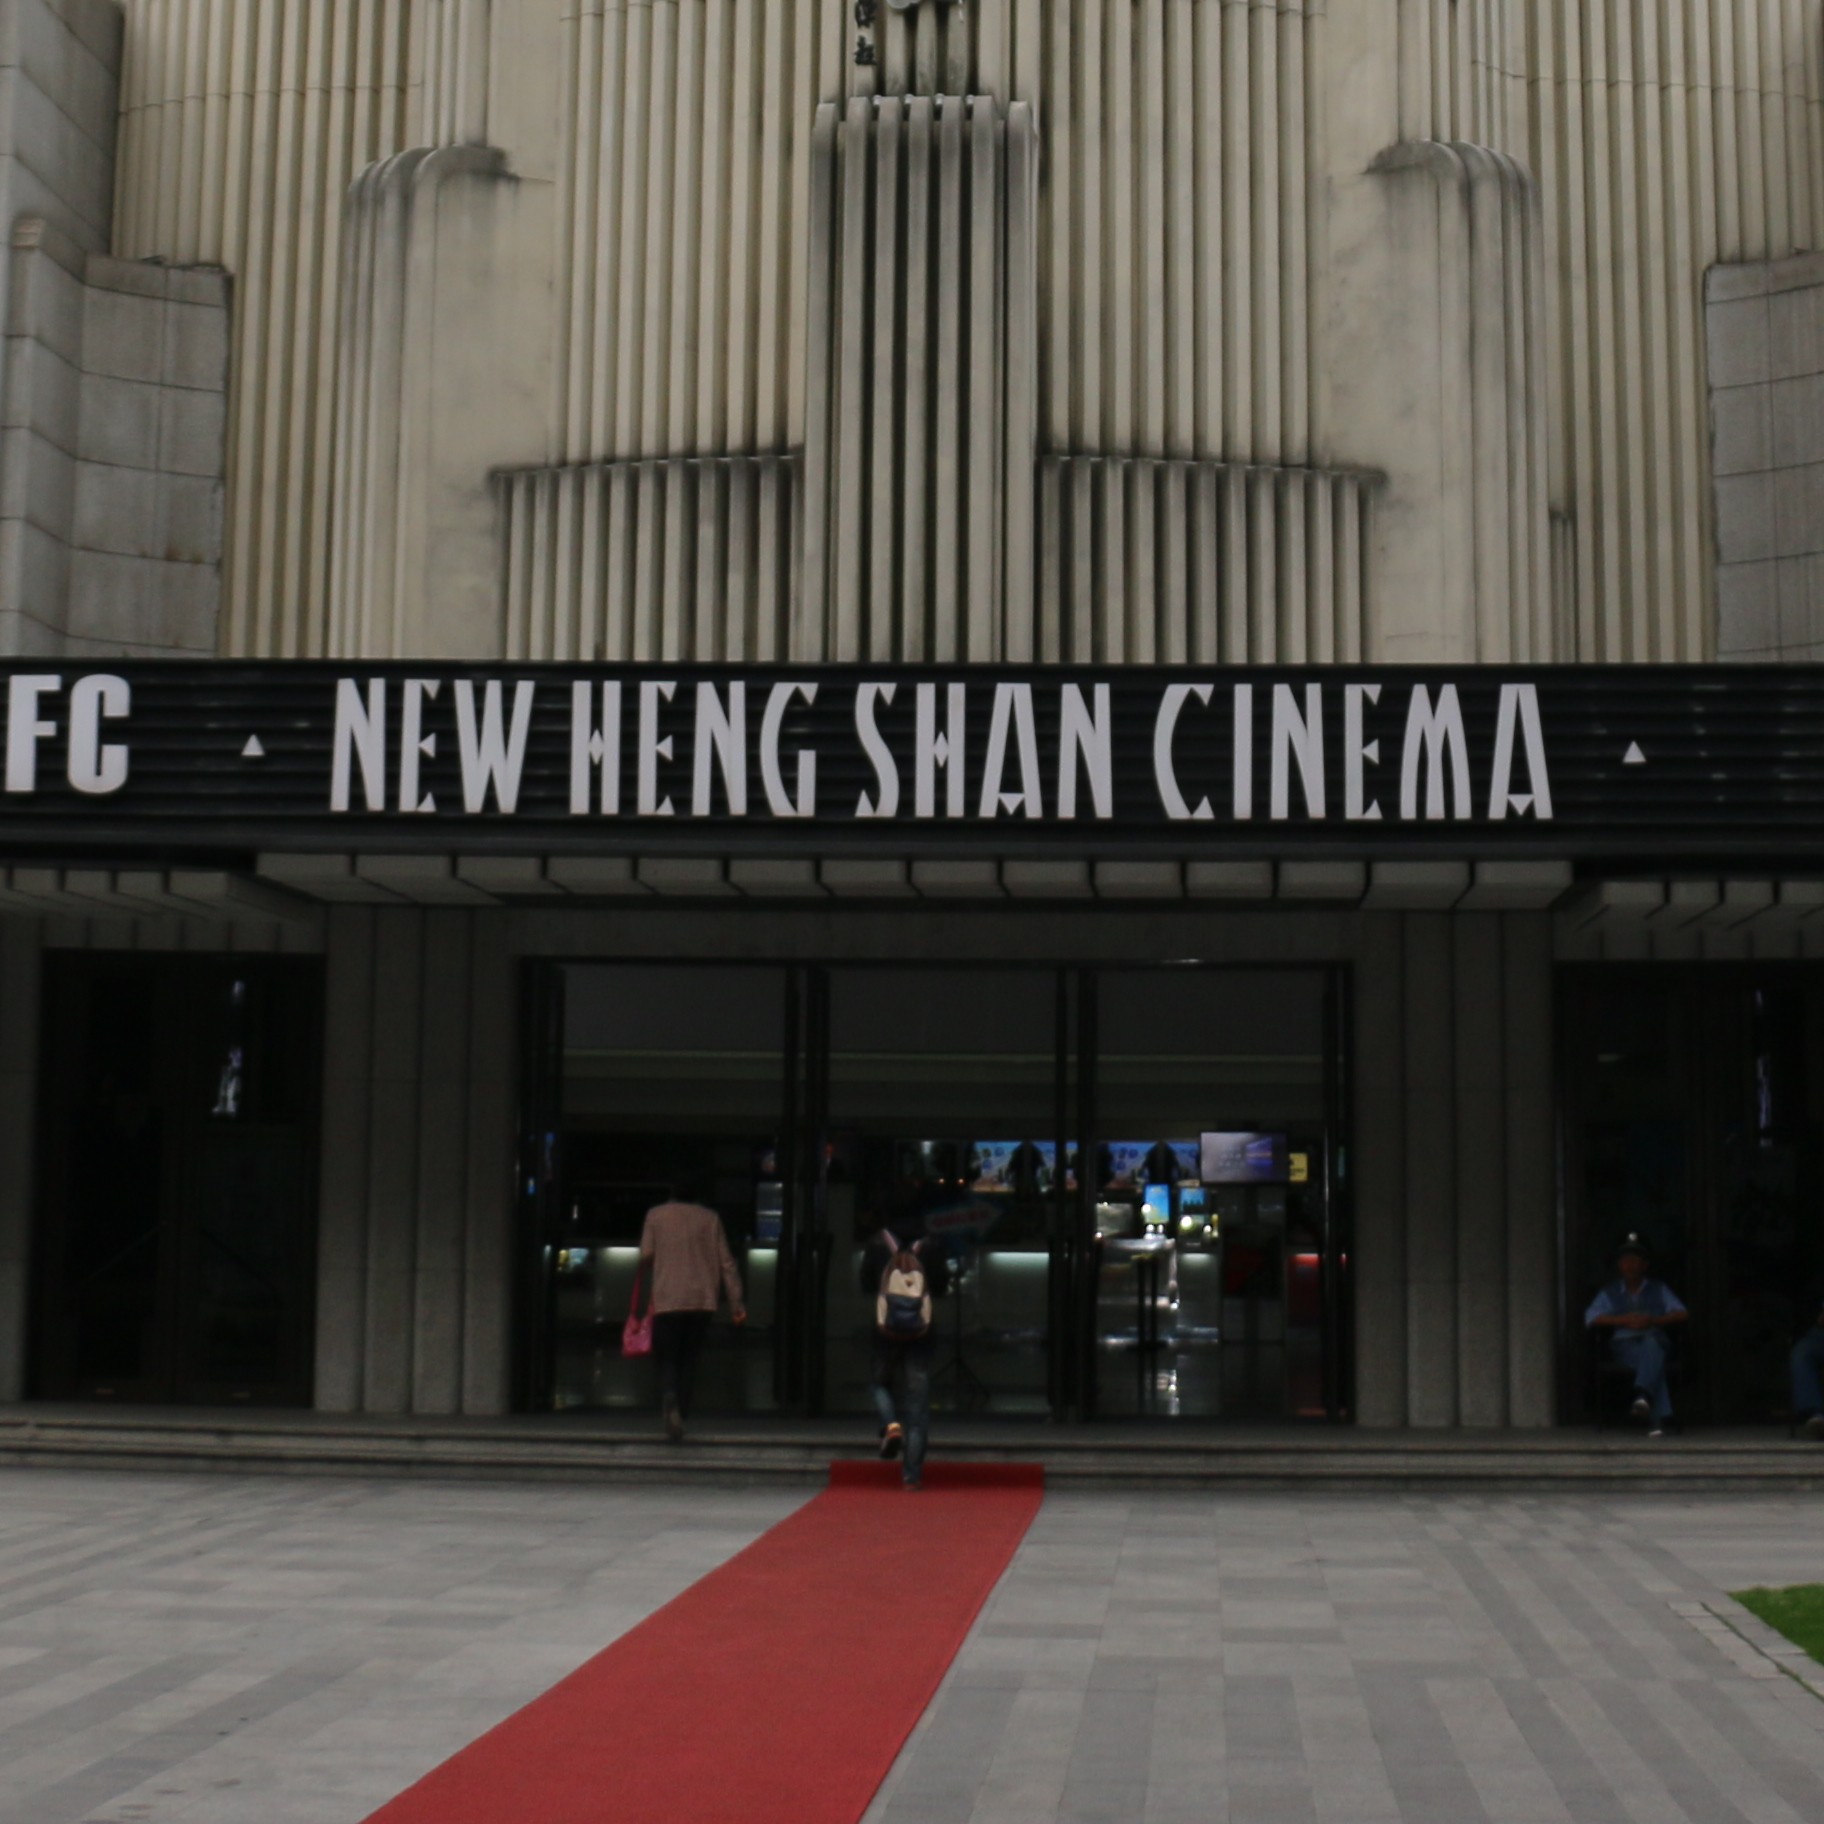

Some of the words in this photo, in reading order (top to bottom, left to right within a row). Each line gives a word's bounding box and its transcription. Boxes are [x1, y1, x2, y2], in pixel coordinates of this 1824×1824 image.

[331, 678, 534, 813] NEW
[568, 681, 818, 817] HENG
[855, 683, 1113, 819] SHAN
[1153, 684, 1553, 821] CINEMA
